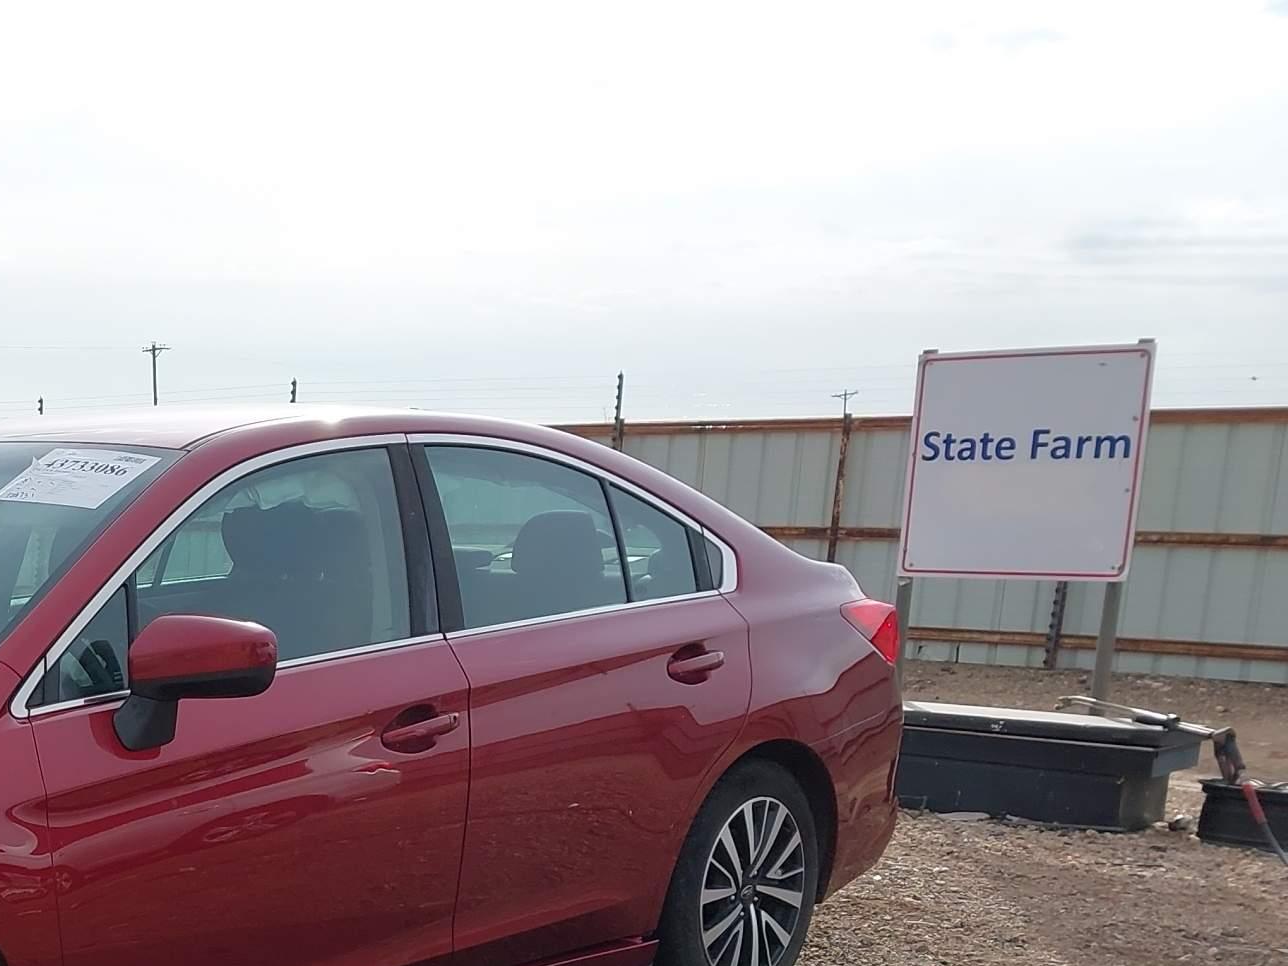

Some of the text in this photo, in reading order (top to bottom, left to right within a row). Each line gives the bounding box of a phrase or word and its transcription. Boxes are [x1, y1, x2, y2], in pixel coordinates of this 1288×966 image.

[921, 428, 1132, 462] State Farm
[44, 458, 128, 477] 43733086
